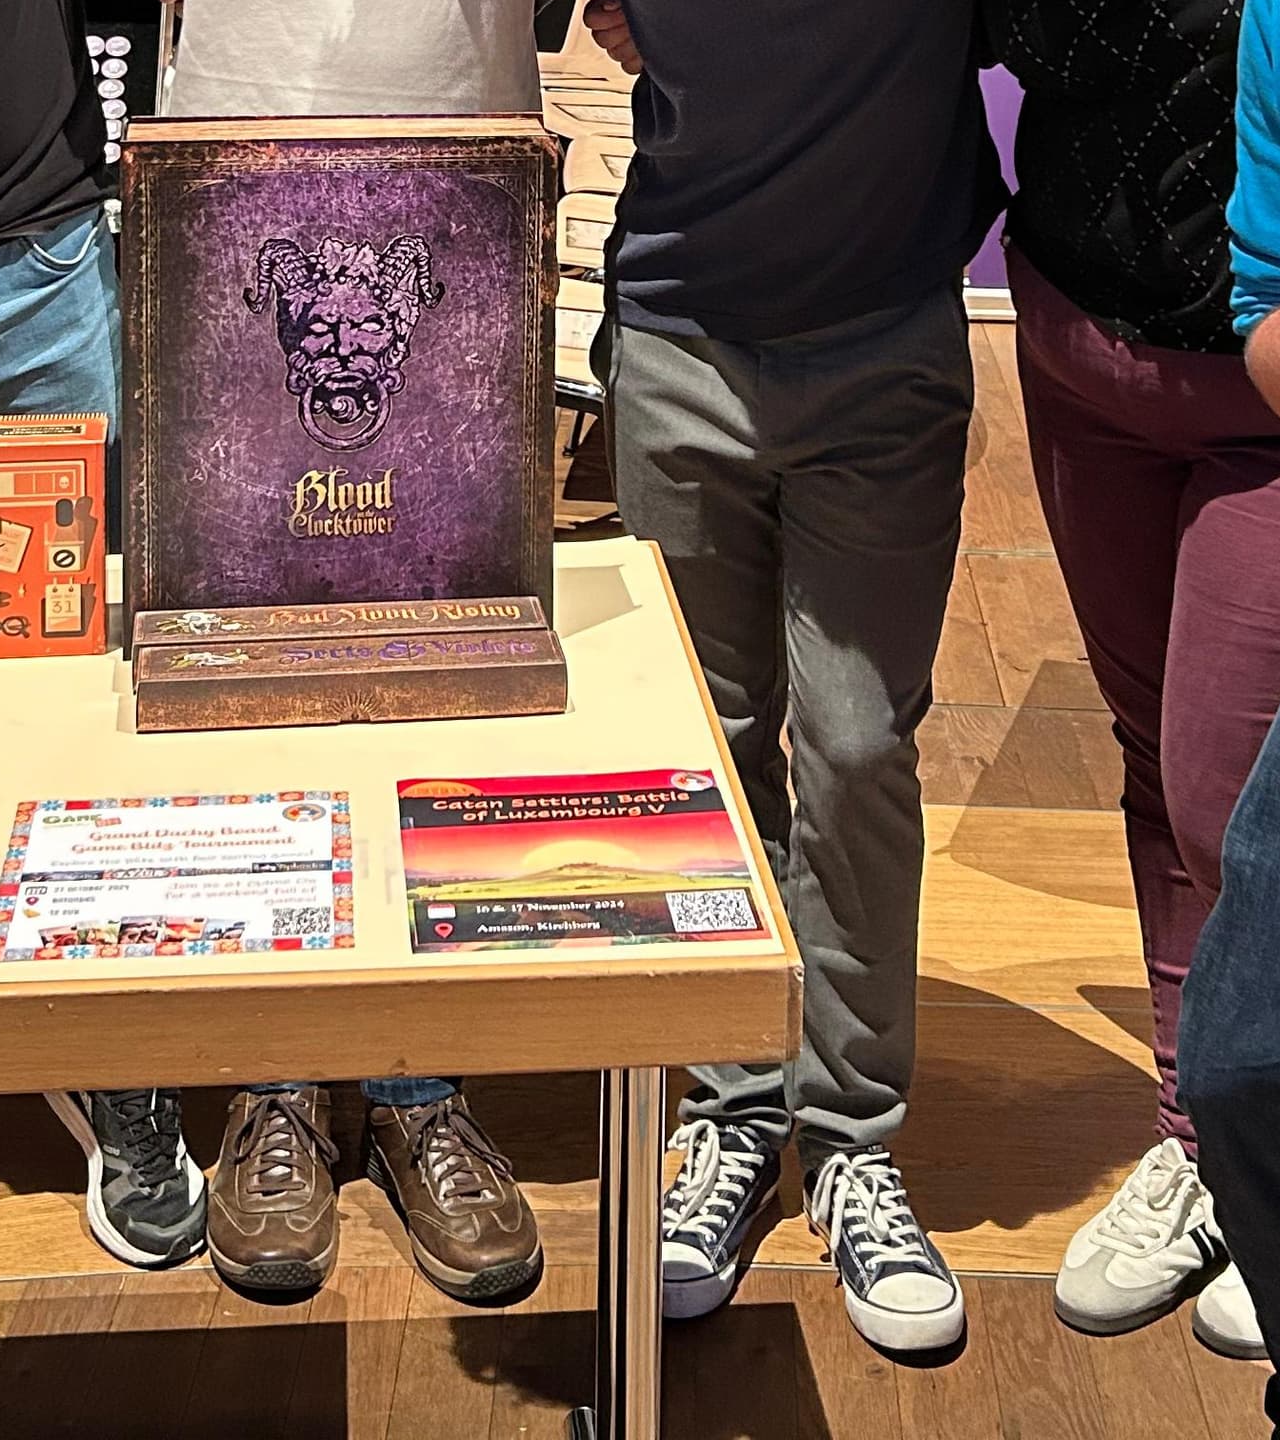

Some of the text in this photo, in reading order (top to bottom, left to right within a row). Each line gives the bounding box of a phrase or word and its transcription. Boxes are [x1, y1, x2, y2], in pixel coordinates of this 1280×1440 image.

[288, 468, 398, 514] Blood
[287, 512, 396, 538] Clocktower
[50, 600, 75, 614] 31
[419, 602, 521, 624] Rising
[432, 791, 690, 810] Catan Settlers: Battle
[42, 813, 102, 825] GAME
[462, 803, 665, 822] of Luxembourg V
[89, 830, 152, 841] Grand
[220, 825, 281, 836] Board
[71, 843, 128, 854] Game
[180, 836, 296, 849] Tournament
[526, 901, 591, 912] November
[536, 920, 601, 932] Kirchberg
